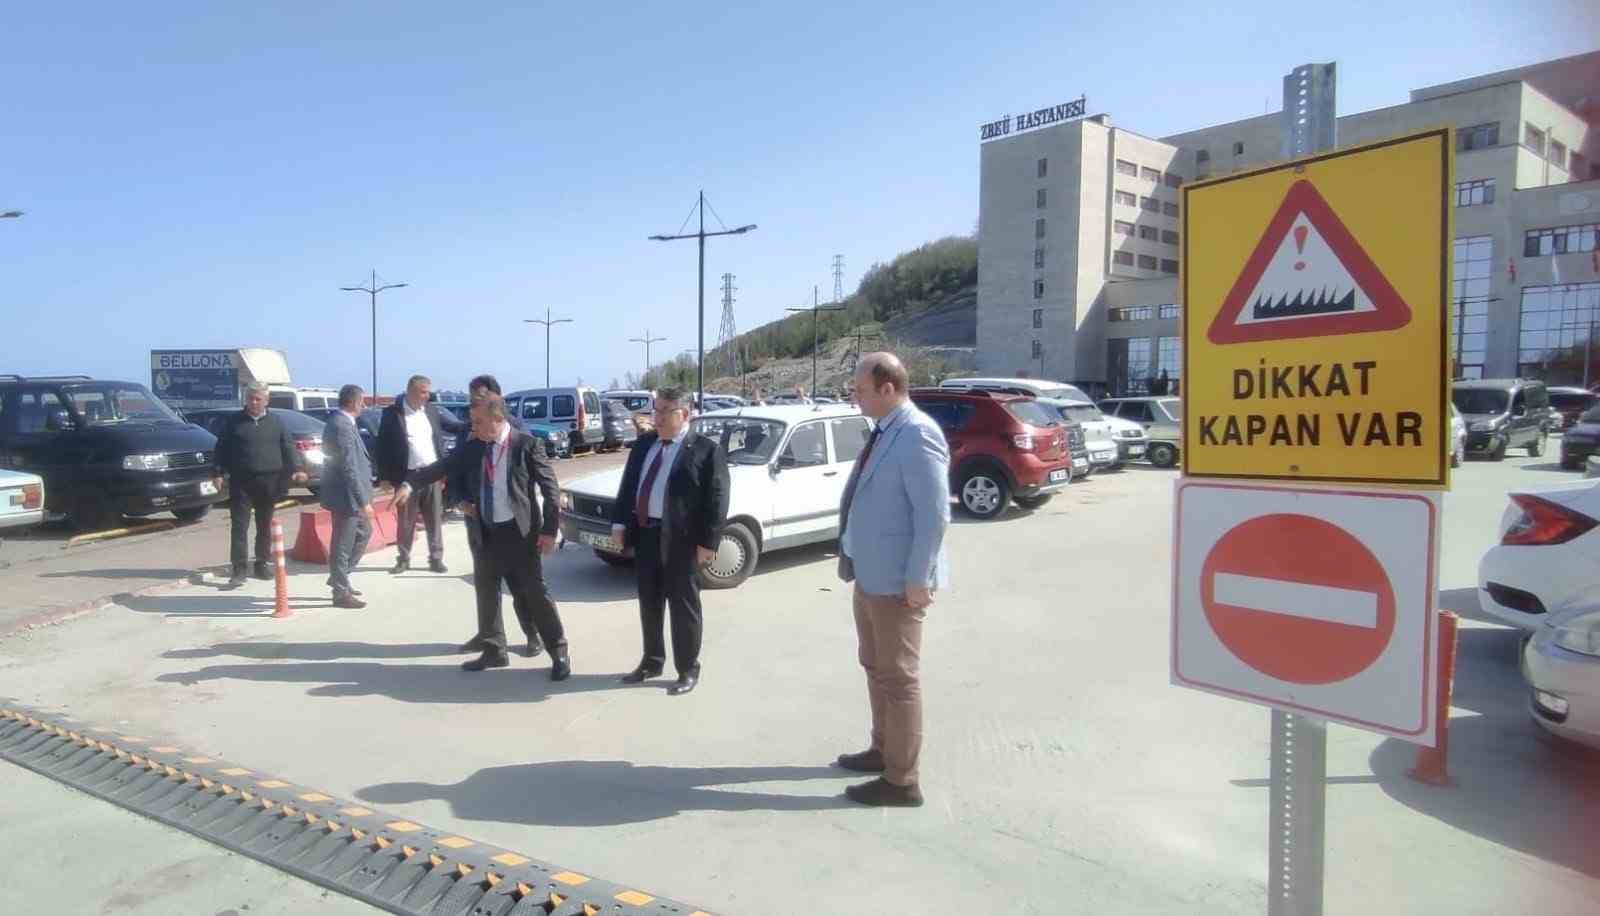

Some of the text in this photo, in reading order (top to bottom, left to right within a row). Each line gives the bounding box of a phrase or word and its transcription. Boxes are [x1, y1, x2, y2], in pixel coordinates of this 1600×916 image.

[1016, 94, 1086, 131] HASTANESİ
[160, 355, 232, 368] BELLONA
[1233, 358, 1377, 400] DİKKAT
[1199, 411, 1423, 447] KAPAN VAR
